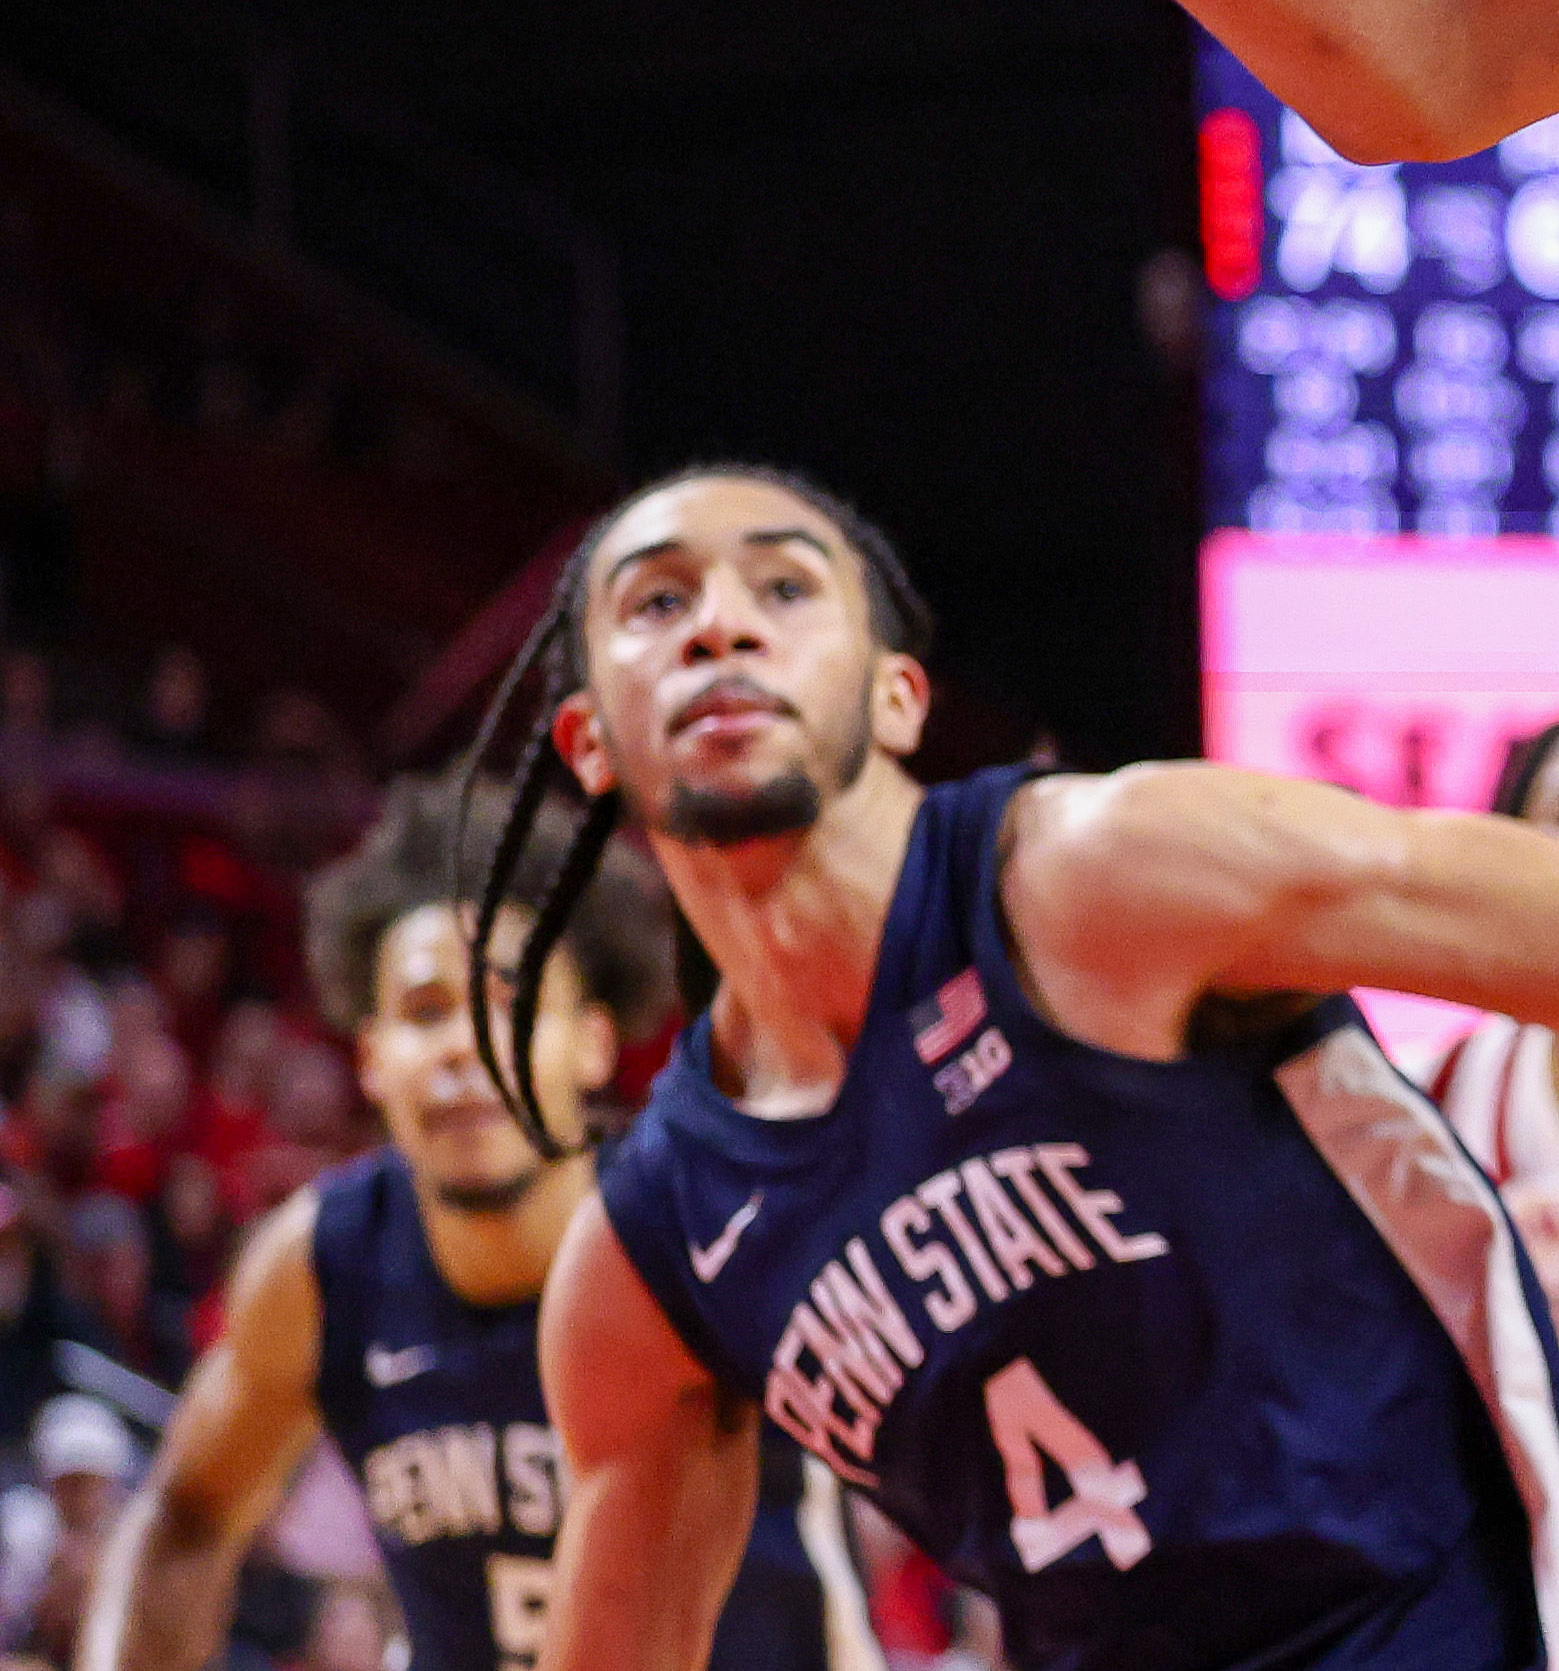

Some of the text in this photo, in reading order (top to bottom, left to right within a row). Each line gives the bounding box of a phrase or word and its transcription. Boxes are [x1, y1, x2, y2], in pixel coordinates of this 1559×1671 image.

[764, 1141, 1170, 1488] PENN STATE
[983, 1354, 1154, 1574] 4
